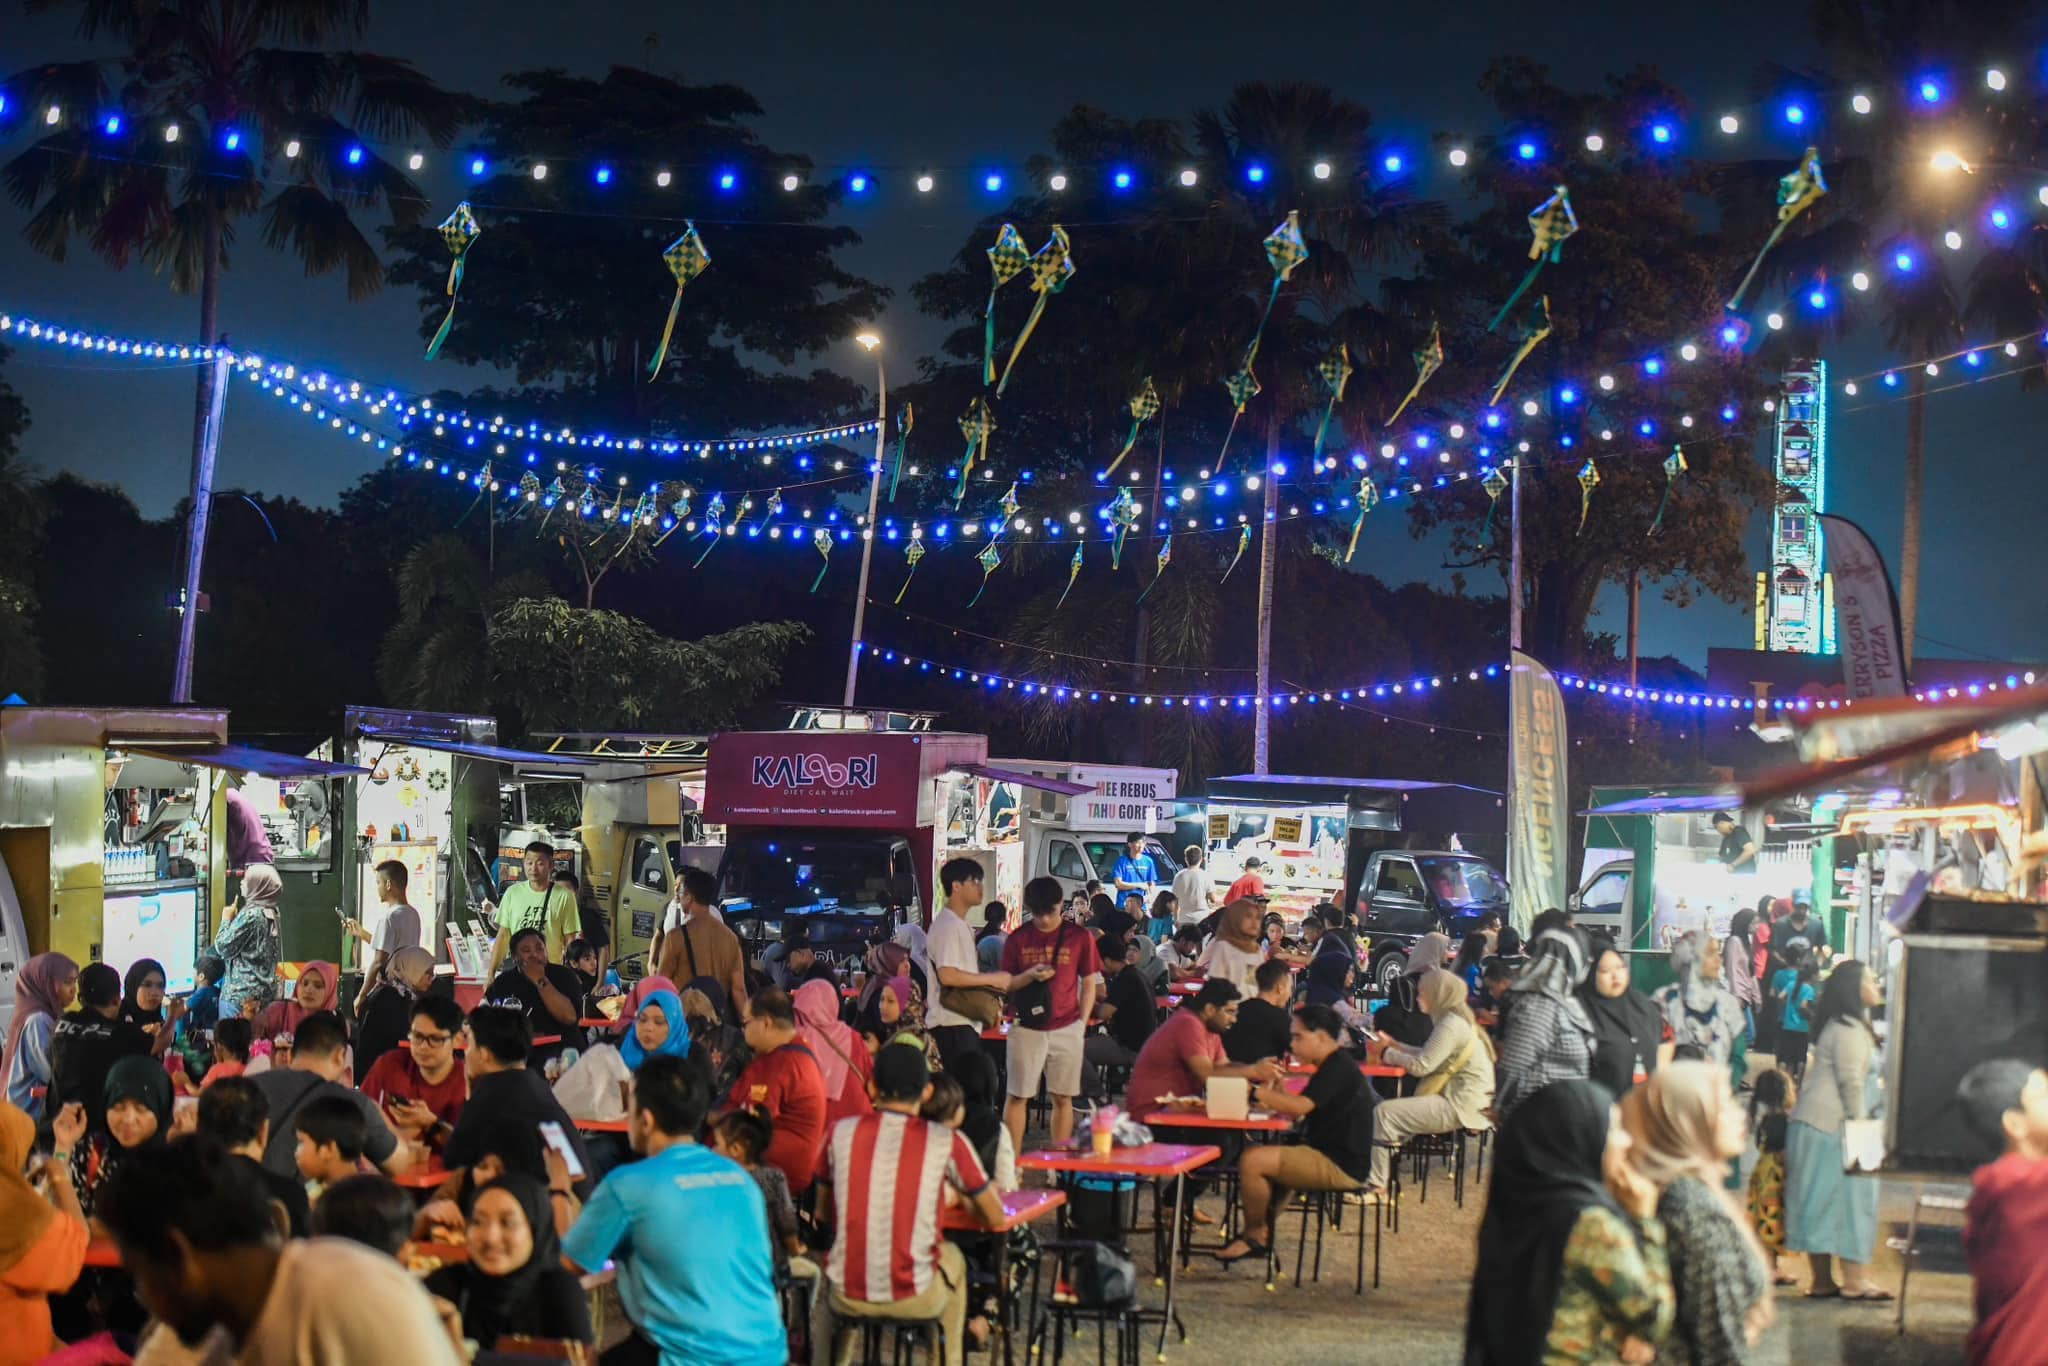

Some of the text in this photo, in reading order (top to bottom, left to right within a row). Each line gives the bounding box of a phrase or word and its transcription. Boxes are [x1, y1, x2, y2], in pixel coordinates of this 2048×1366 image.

[1845, 595, 1873, 698] ERRYSON'S
[1869, 624, 1893, 679] PIZZA
[752, 753, 877, 788] KALOORI
[1096, 781, 1156, 798] MEE REBUS
[1088, 803, 1162, 820] TAHU GOREG
